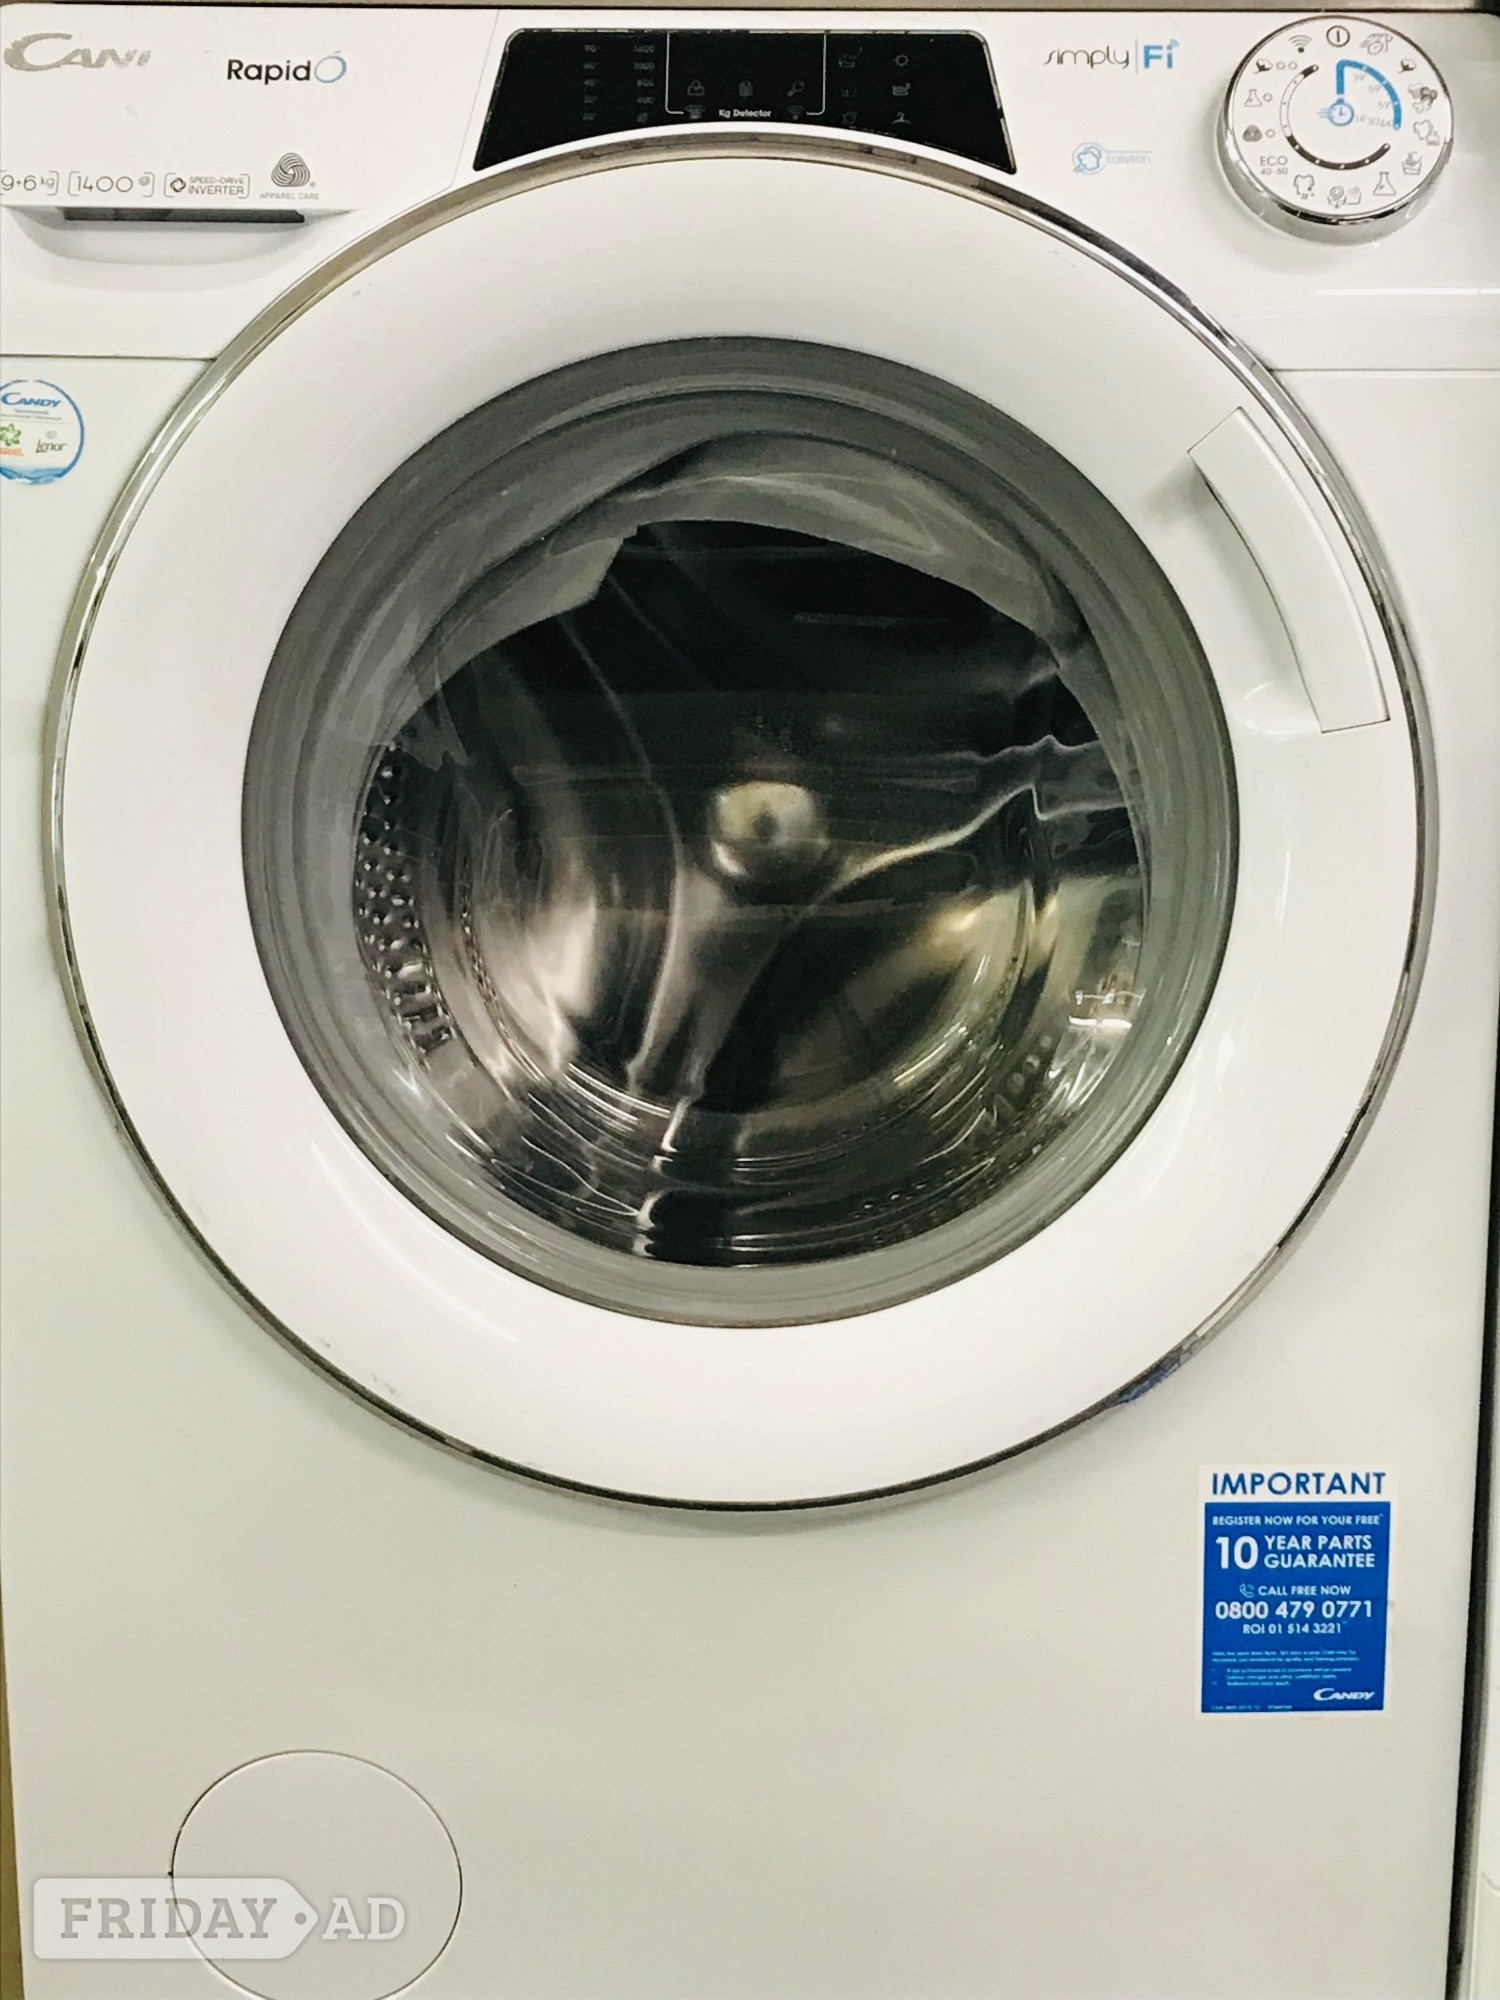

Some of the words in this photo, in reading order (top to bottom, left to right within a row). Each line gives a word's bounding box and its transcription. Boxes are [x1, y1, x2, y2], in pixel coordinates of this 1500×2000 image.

[1044, 45, 1129, 69] simply
[1143, 39, 1180, 69] Fi
[719, 109, 731, 118] Kg
[733, 109, 771, 117] Detector
[1260, 155, 1288, 166] ECO
[77, 175, 133, 193] 1400
[189, 176, 245, 185] SPEED-DRIVE
[188, 185, 244, 195] INVERTER
[260, 192, 296, 200] APPAREL
[36, 439, 67, 453] Lenor
[1212, 1472, 1386, 1495] IMPORTANT
[1212, 1516, 1261, 1526] REGISTER
[1264, 1516, 1293, 1525] NOW
[1296, 1515, 1318, 1525] FOR
[1321, 1515, 1352, 1525] YOUR
[1216, 1535, 1259, 1569] 10
[1264, 1535, 1312, 1550] YEAR
[1318, 1535, 1372, 1550] PARTS
[1264, 1553, 1375, 1568] GUARANTEE
[1258, 1585, 1288, 1596] CALL
[1291, 1585, 1317, 1595] FREE
[1320, 1585, 1351, 1595] NOW
[1215, 1601, 1269, 1619] 0800
[1275, 1601, 1315, 1618] 479
[1321, 1600, 1372, 1618] 0771
[1242, 1623, 1265, 1634] ROI
[1268, 1623, 1282, 1634] 01
[1287, 1623, 1309, 1634] 514
[1313, 1622, 1341, 1634] 3221
